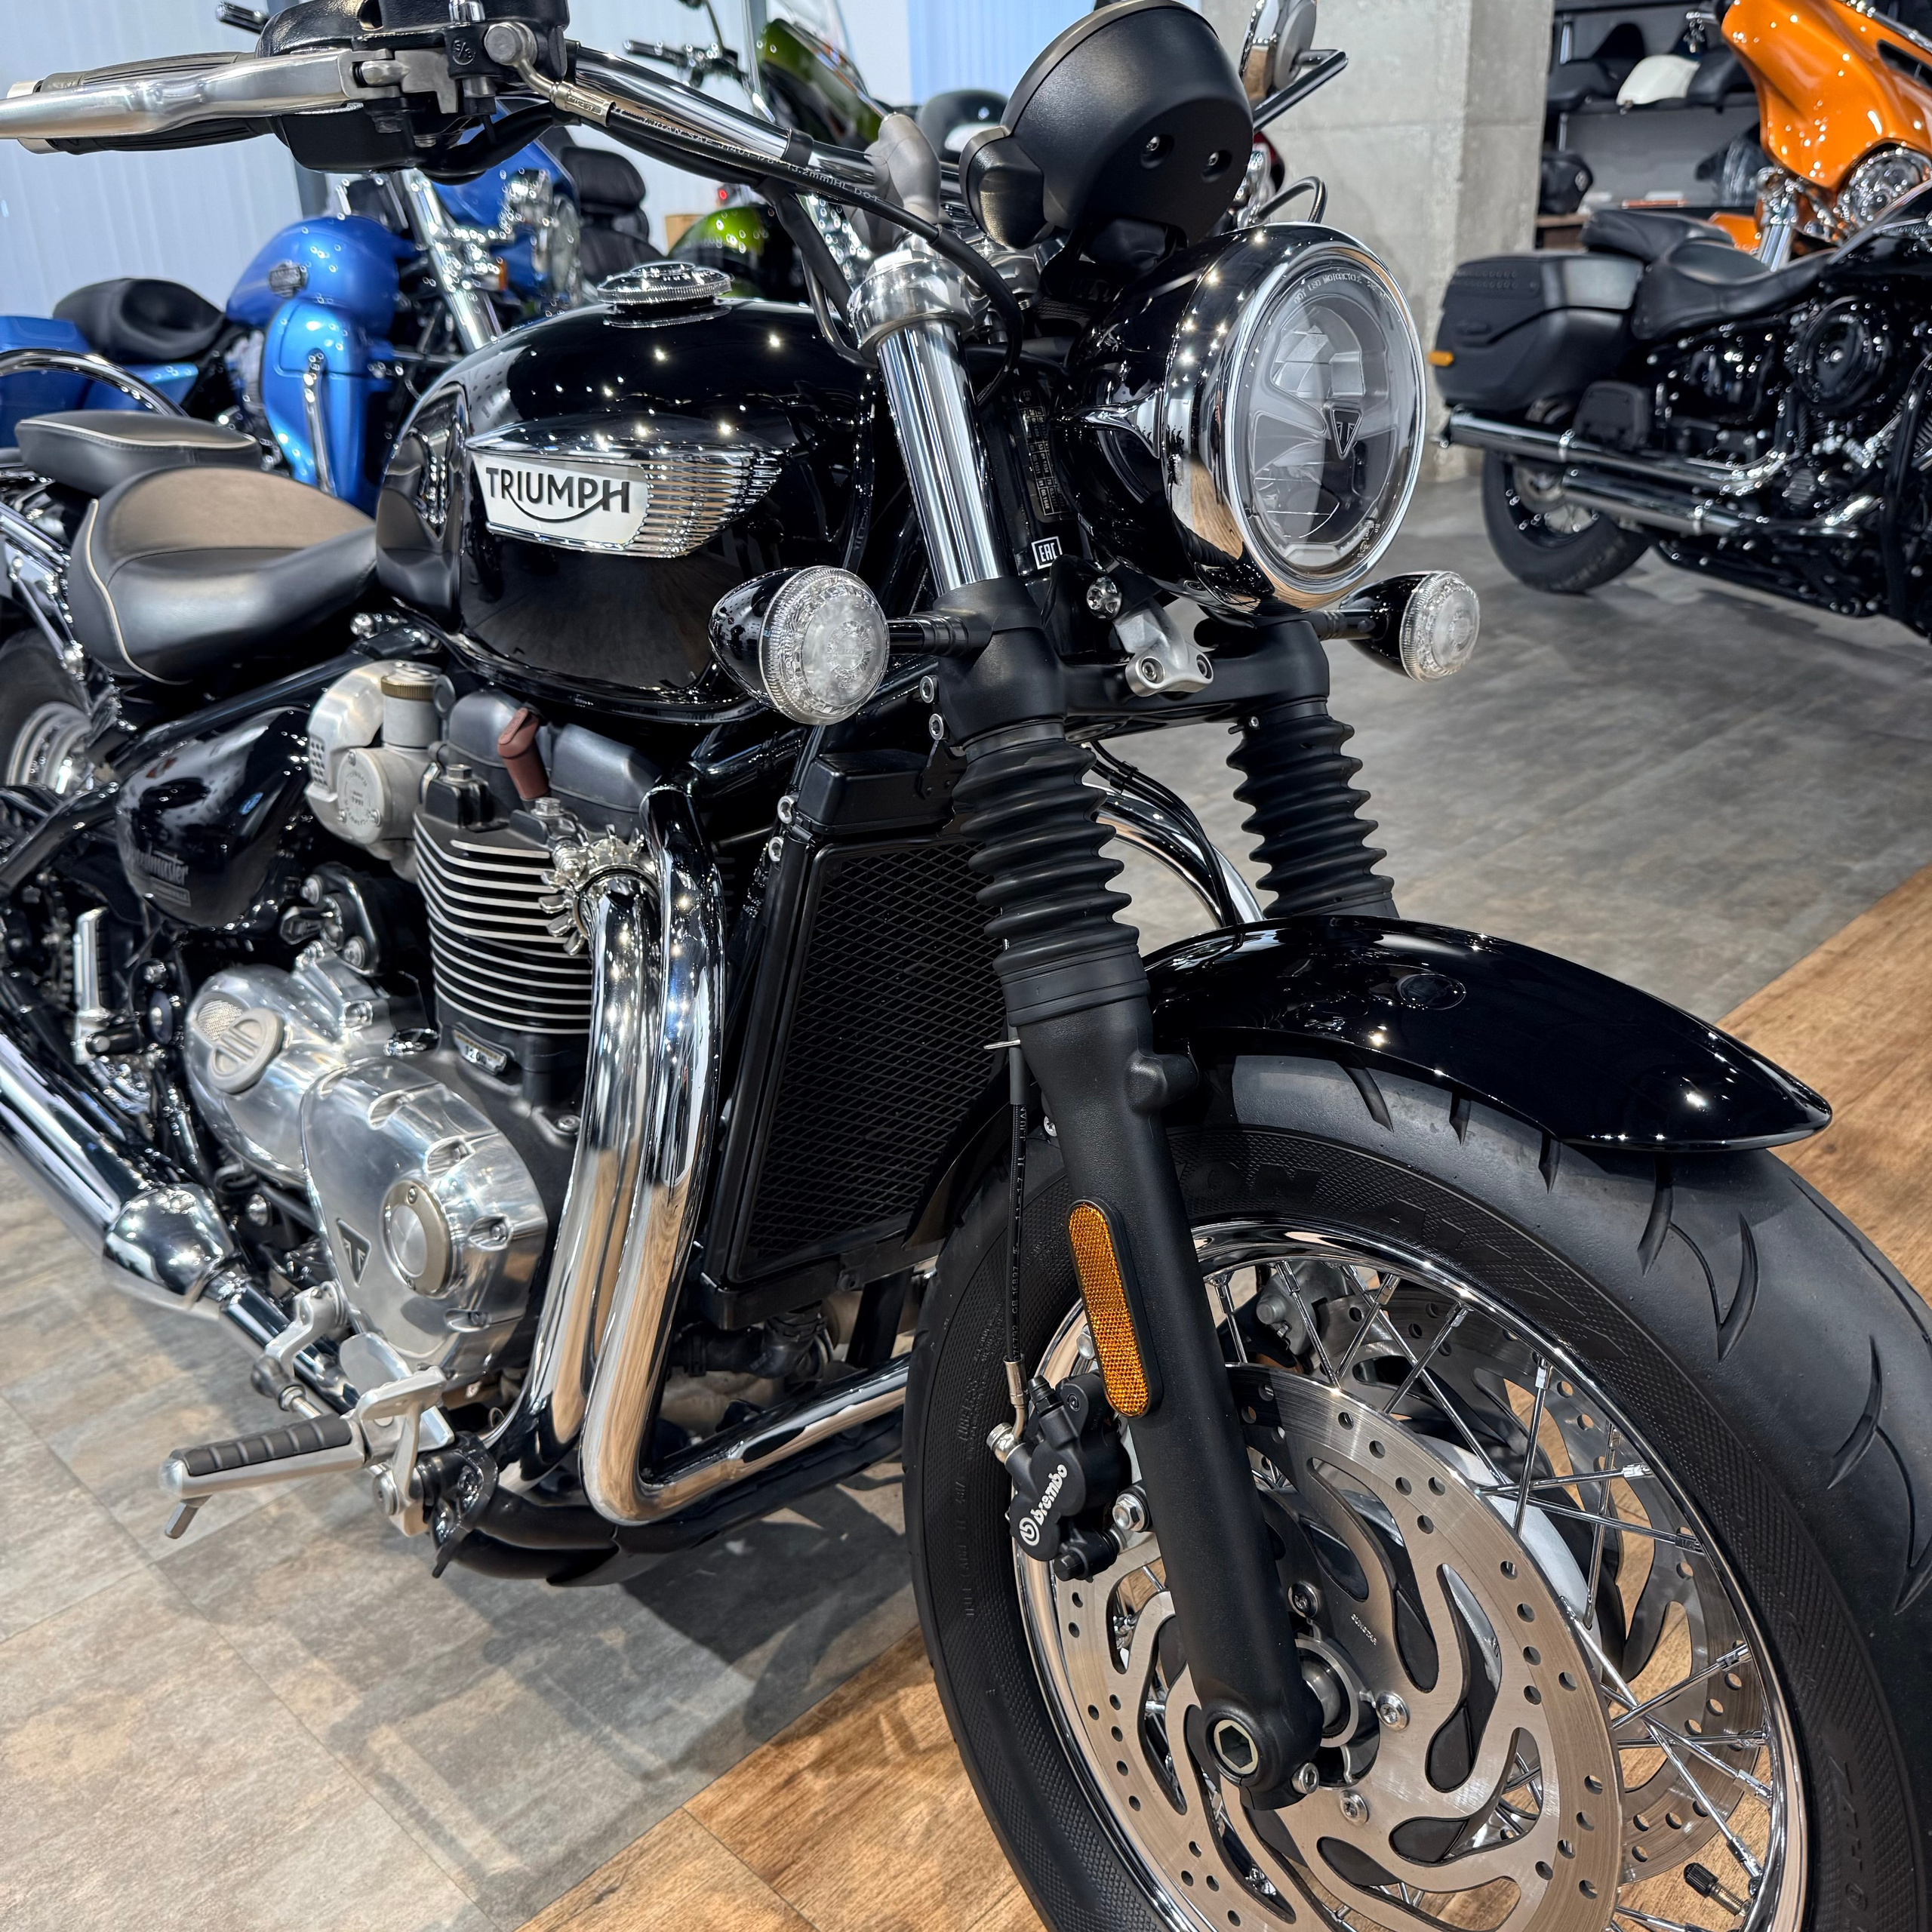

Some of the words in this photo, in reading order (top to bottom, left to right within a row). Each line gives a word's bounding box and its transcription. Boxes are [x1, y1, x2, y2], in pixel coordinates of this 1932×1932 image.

[688, 132, 714, 146] SAE
[485, 466, 630, 523] TRIUMPH
[1029, 1463, 1068, 1526] brembo
